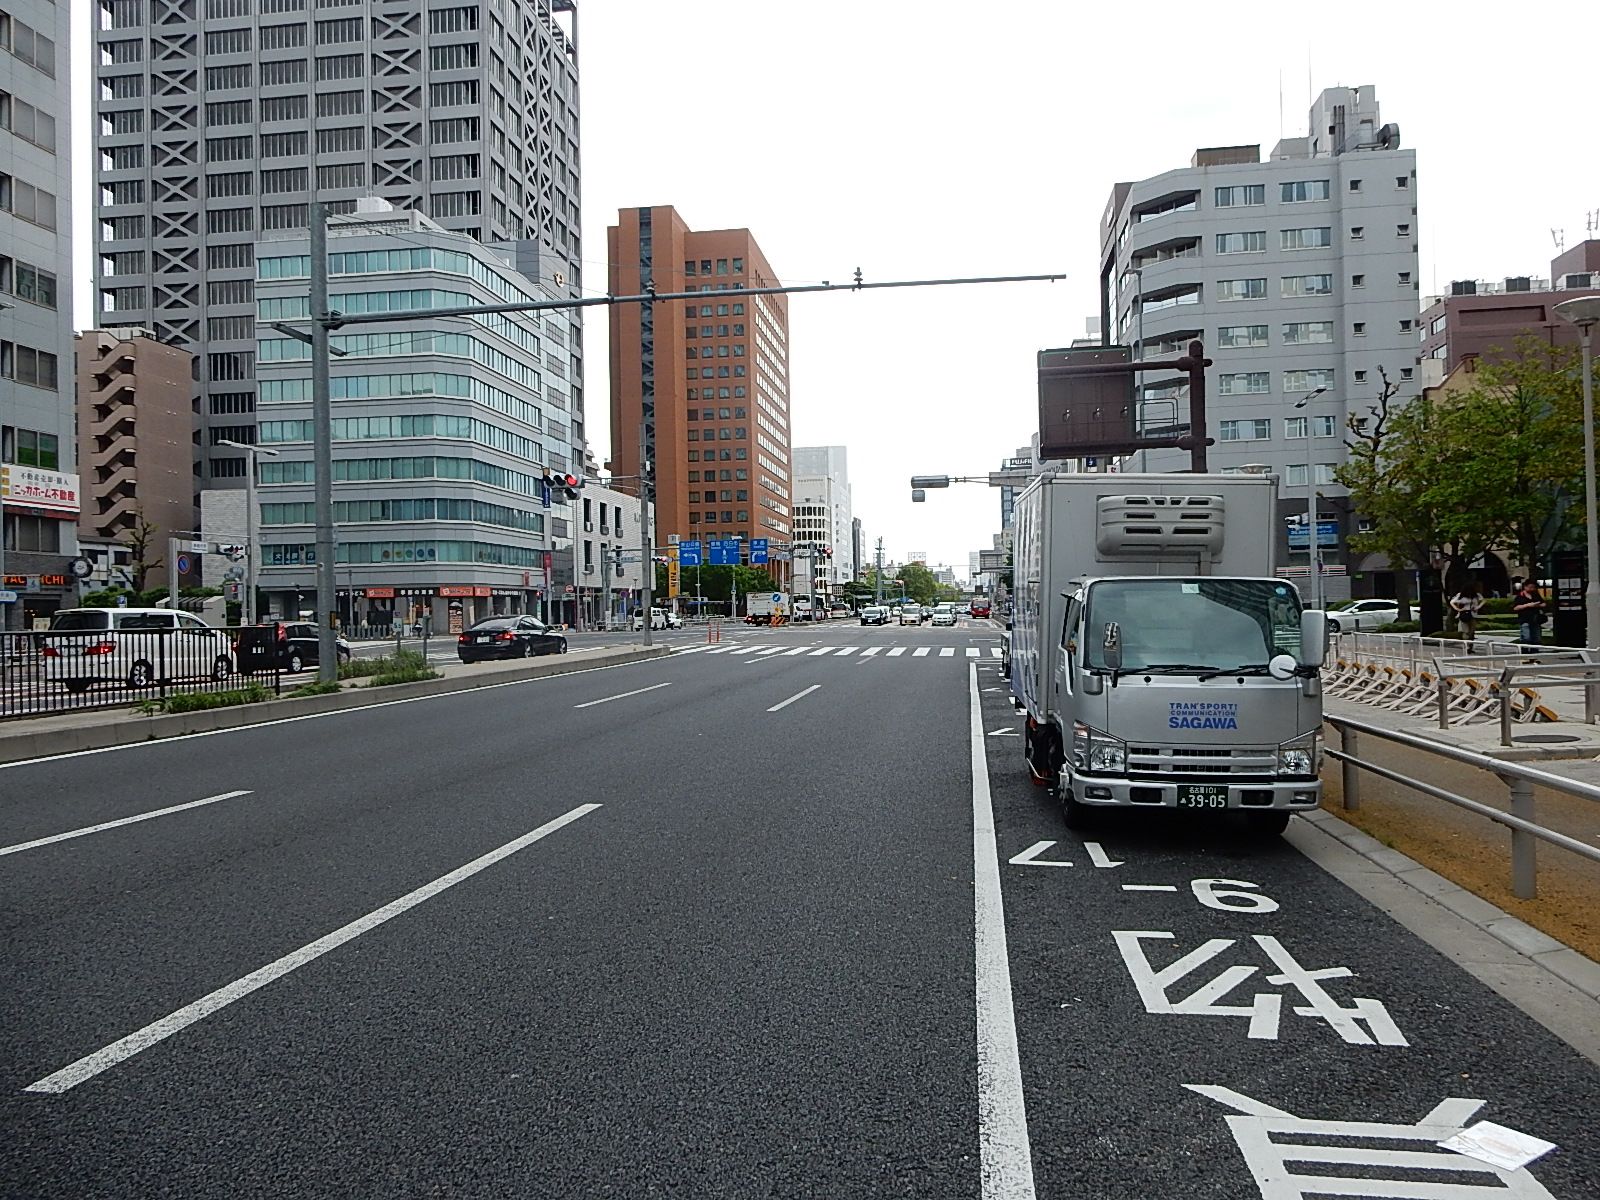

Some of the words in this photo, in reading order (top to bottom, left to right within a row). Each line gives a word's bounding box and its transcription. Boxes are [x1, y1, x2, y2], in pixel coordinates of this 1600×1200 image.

[14, 484, 76, 501] ニッカホーム不動産
[1169, 716, 1238, 730] SAGAWA
